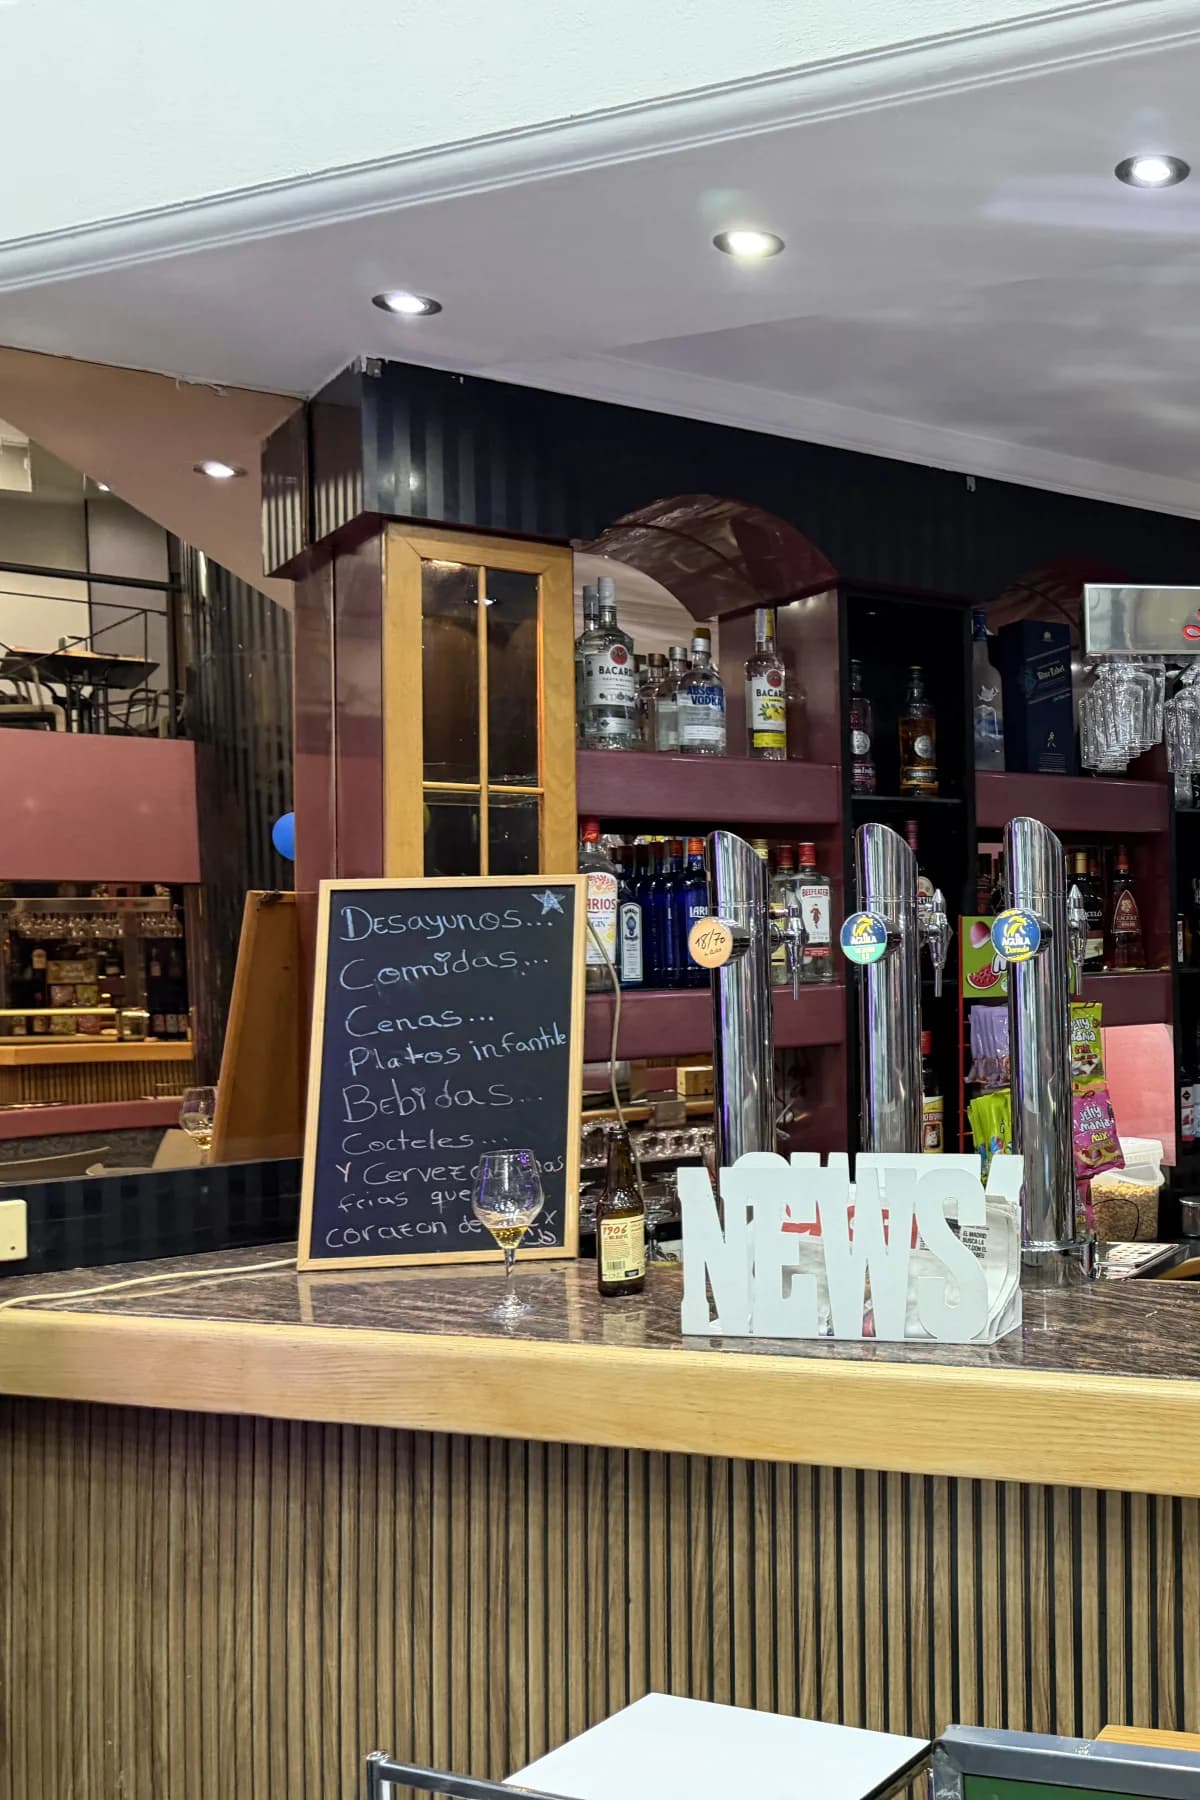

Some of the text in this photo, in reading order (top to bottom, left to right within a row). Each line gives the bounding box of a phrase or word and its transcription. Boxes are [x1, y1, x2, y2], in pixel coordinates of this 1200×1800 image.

[598, 665, 633, 677] BACARD
[756, 688, 785, 698] BACAR
[586, 897, 617, 911] ARIOS
[689, 905, 708, 917] LARI
[695, 928, 726, 950] 18/70
[349, 1042, 461, 1076] Platos
[602, 1224, 628, 1236] 1906
[677, 1166, 990, 1344] NEWS
